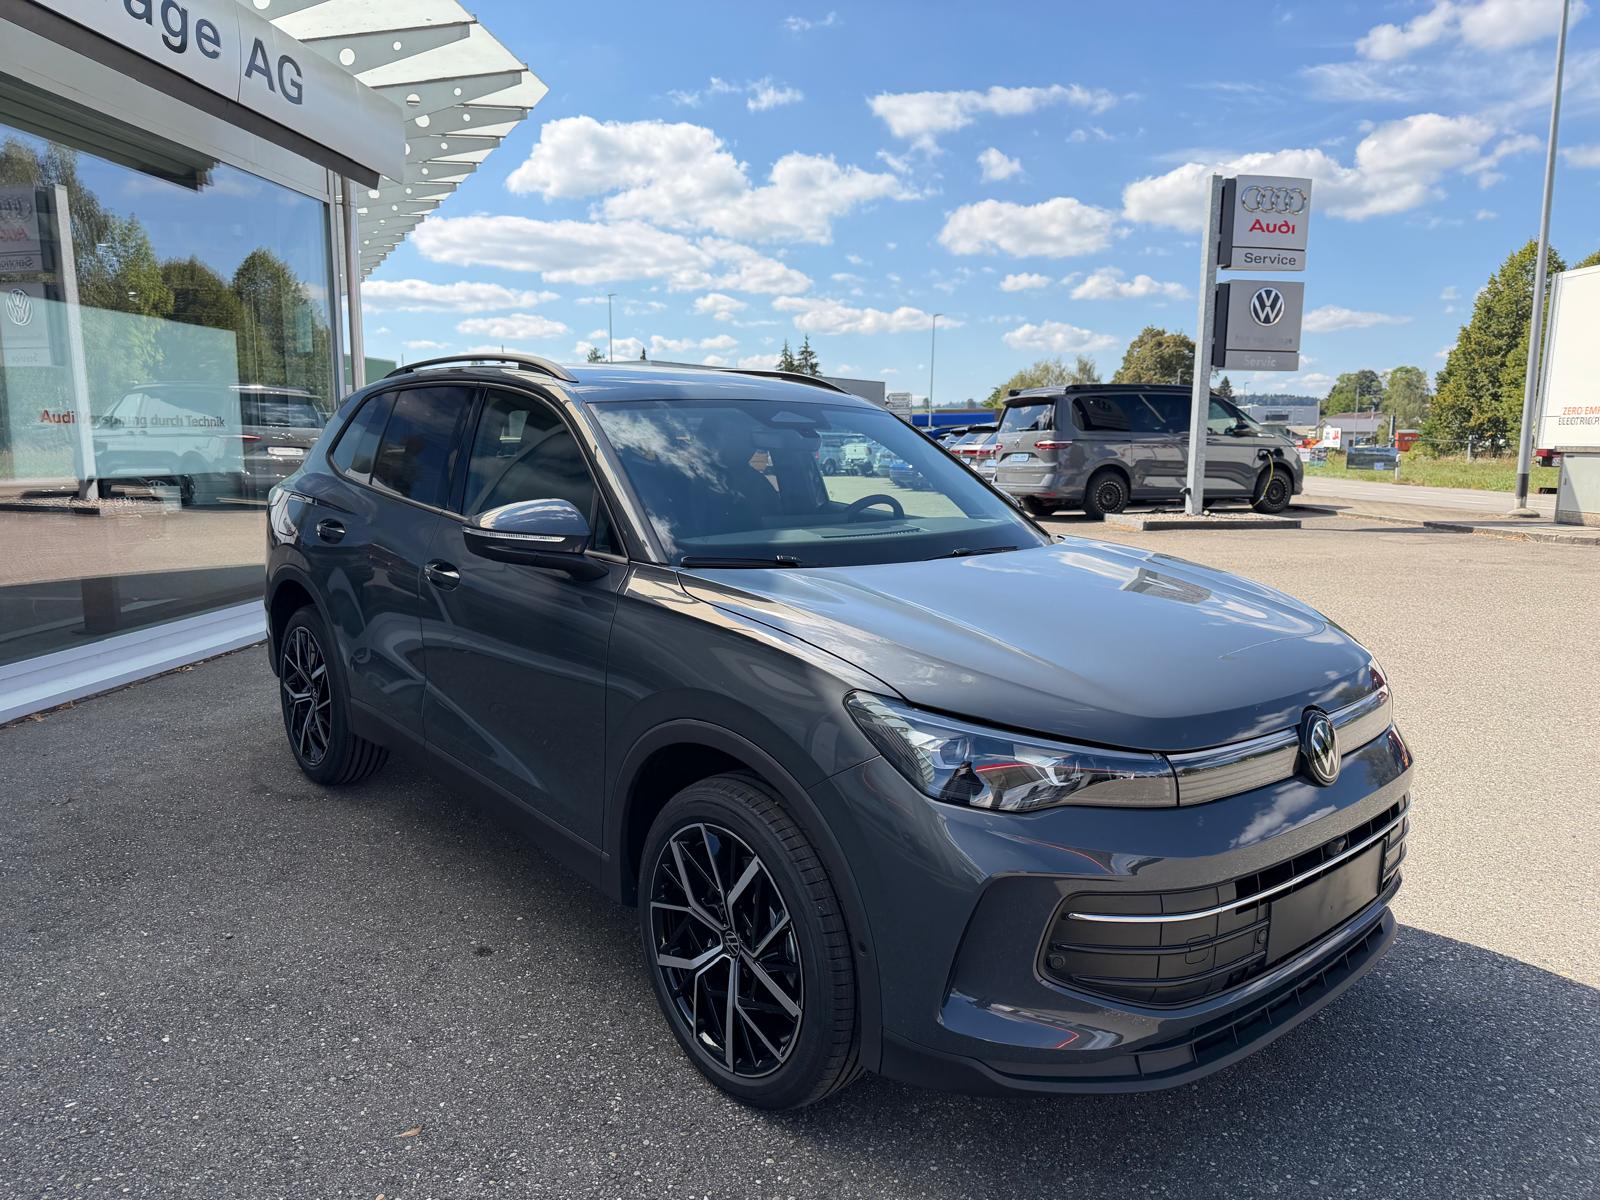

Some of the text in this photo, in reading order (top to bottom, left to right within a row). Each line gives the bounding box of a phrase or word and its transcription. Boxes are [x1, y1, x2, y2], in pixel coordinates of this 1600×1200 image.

[104, 0, 303, 105] age AG
[1249, 218, 1295, 234] Audi
[1243, 252, 1297, 266] Service
[1243, 354, 1277, 368] Servic
[1562, 406, 1583, 415] ZERO
[40, 409, 75, 424] Audi
[151, 413, 184, 427] durch
[186, 414, 226, 428] Technik
